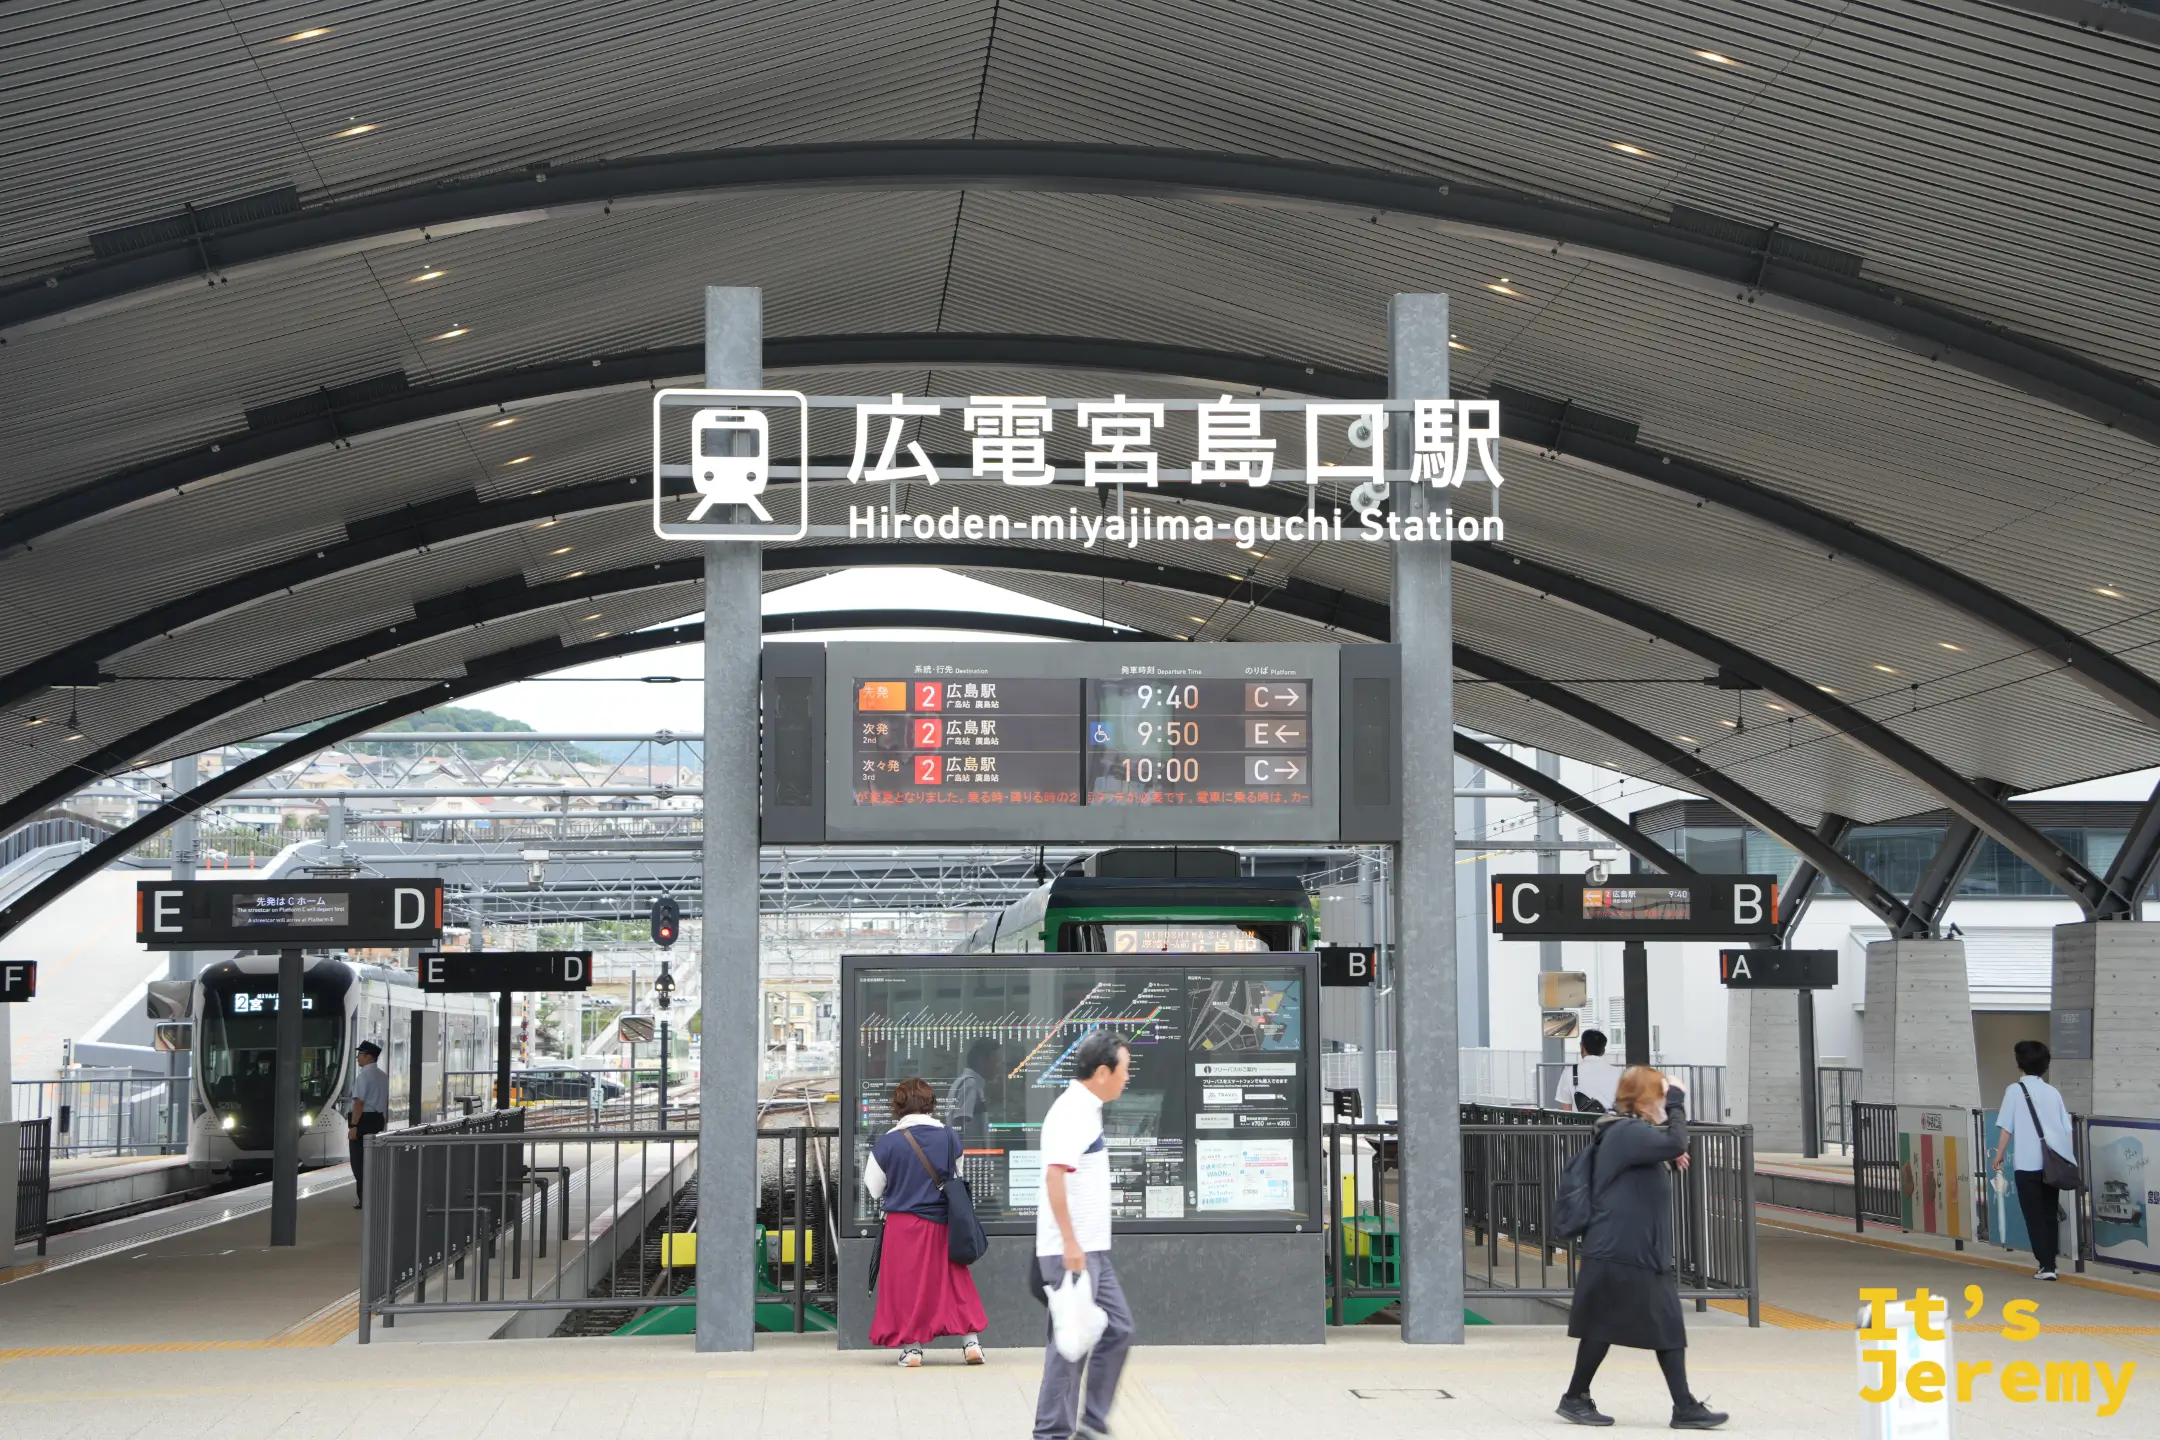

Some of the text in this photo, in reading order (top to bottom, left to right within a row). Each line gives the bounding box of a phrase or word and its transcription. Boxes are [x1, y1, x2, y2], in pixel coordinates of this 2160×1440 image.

[847, 392, 1504, 489] 広電宮島口駅
[848, 505, 1505, 550] Hiroden-miyajima-guchi Station
[955, 667, 988, 675] Destination
[1121, 666, 1155, 675] 発車時刻
[1157, 668, 1186, 676] Departure
[1245, 666, 1268, 675] のりば
[922, 685, 935, 707] 2
[946, 682, 996, 699] 広島駅
[1137, 684, 1199, 709] 9:40
[1254, 686, 1269, 708] C
[862, 723, 889, 736] 次発
[922, 722, 935, 744] 2
[946, 719, 996, 736] 広島駅
[1137, 721, 1199, 746] 9:50
[1254, 723, 1269, 744] E
[862, 736, 877, 744] 2nd
[862, 759, 900, 772] 次々発
[922, 759, 935, 781] 2
[946, 756, 996, 772] 広島駅
[1122, 757, 1199, 783] 10:00
[1254, 759, 1269, 781] C
[862, 773, 876, 781] 3rd
[1512, 882, 1540, 925] C
[1612, 890, 1637, 899] 広島駅
[1668, 890, 1688, 899] 9:40
[1733, 883, 1763, 925] B
[154, 889, 184, 933] E
[394, 887, 426, 931] D
[1117, 933, 1136, 952] 2
[1144, 931, 1204, 939] HIROSHIMA
[427, 957, 446, 983] E
[563, 956, 583, 982] D
[1348, 952, 1367, 977] B
[1731, 954, 1752, 979] A
[4, 967, 23, 992] F
